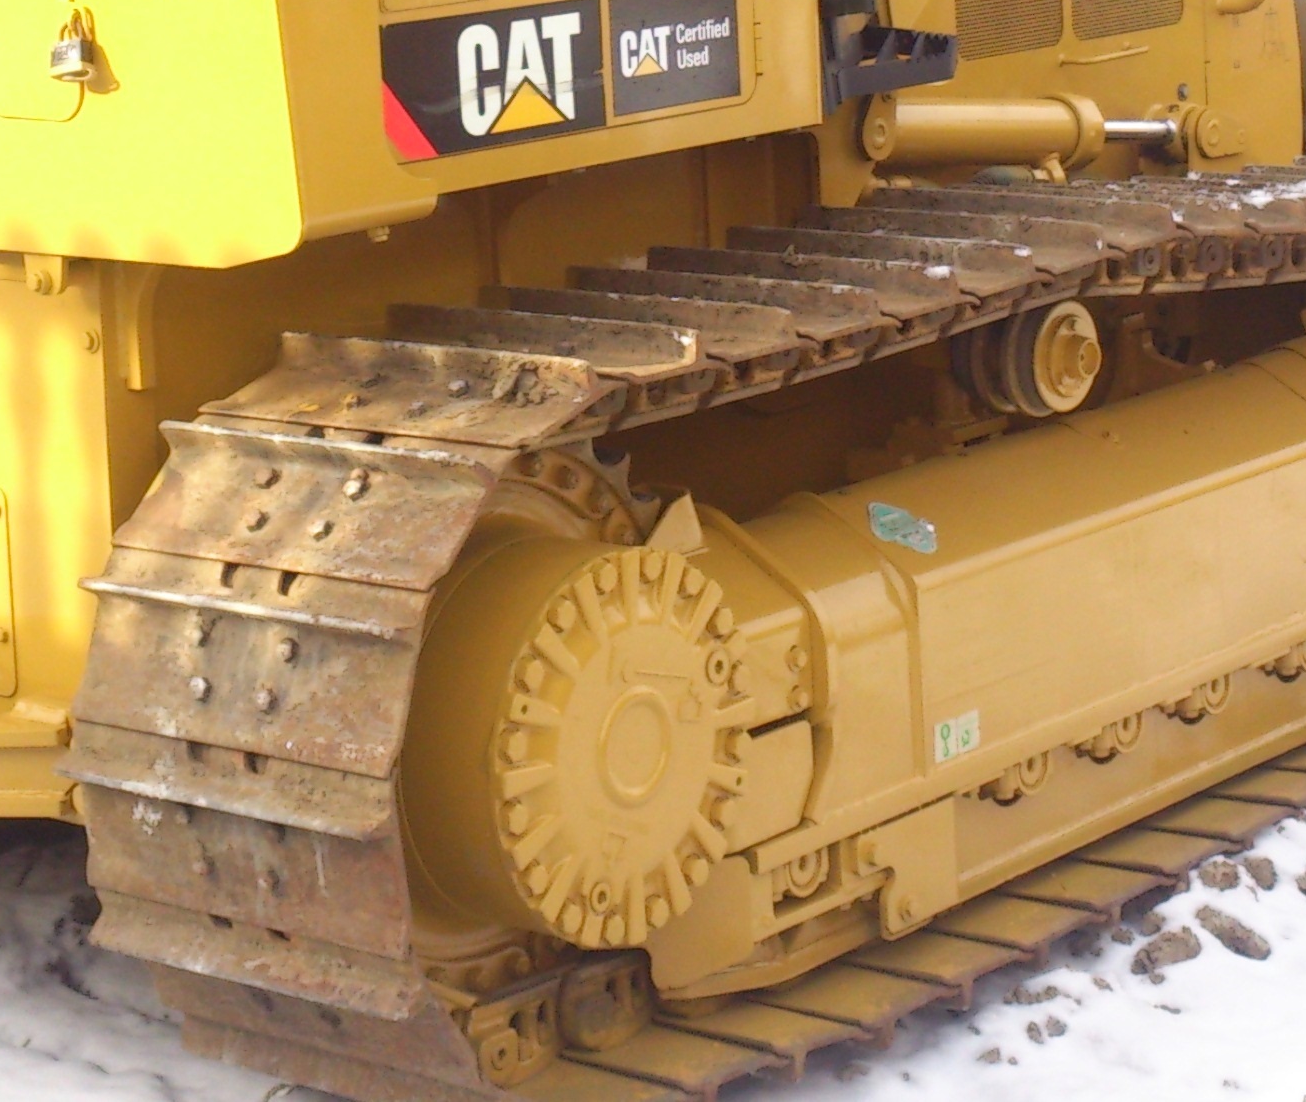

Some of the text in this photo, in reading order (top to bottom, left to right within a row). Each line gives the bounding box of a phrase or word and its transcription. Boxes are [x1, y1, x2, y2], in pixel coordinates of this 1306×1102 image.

[457, 12, 582, 137] CAT
[619, 16, 730, 78] CAT Certified
[676, 45, 709, 69] Used
